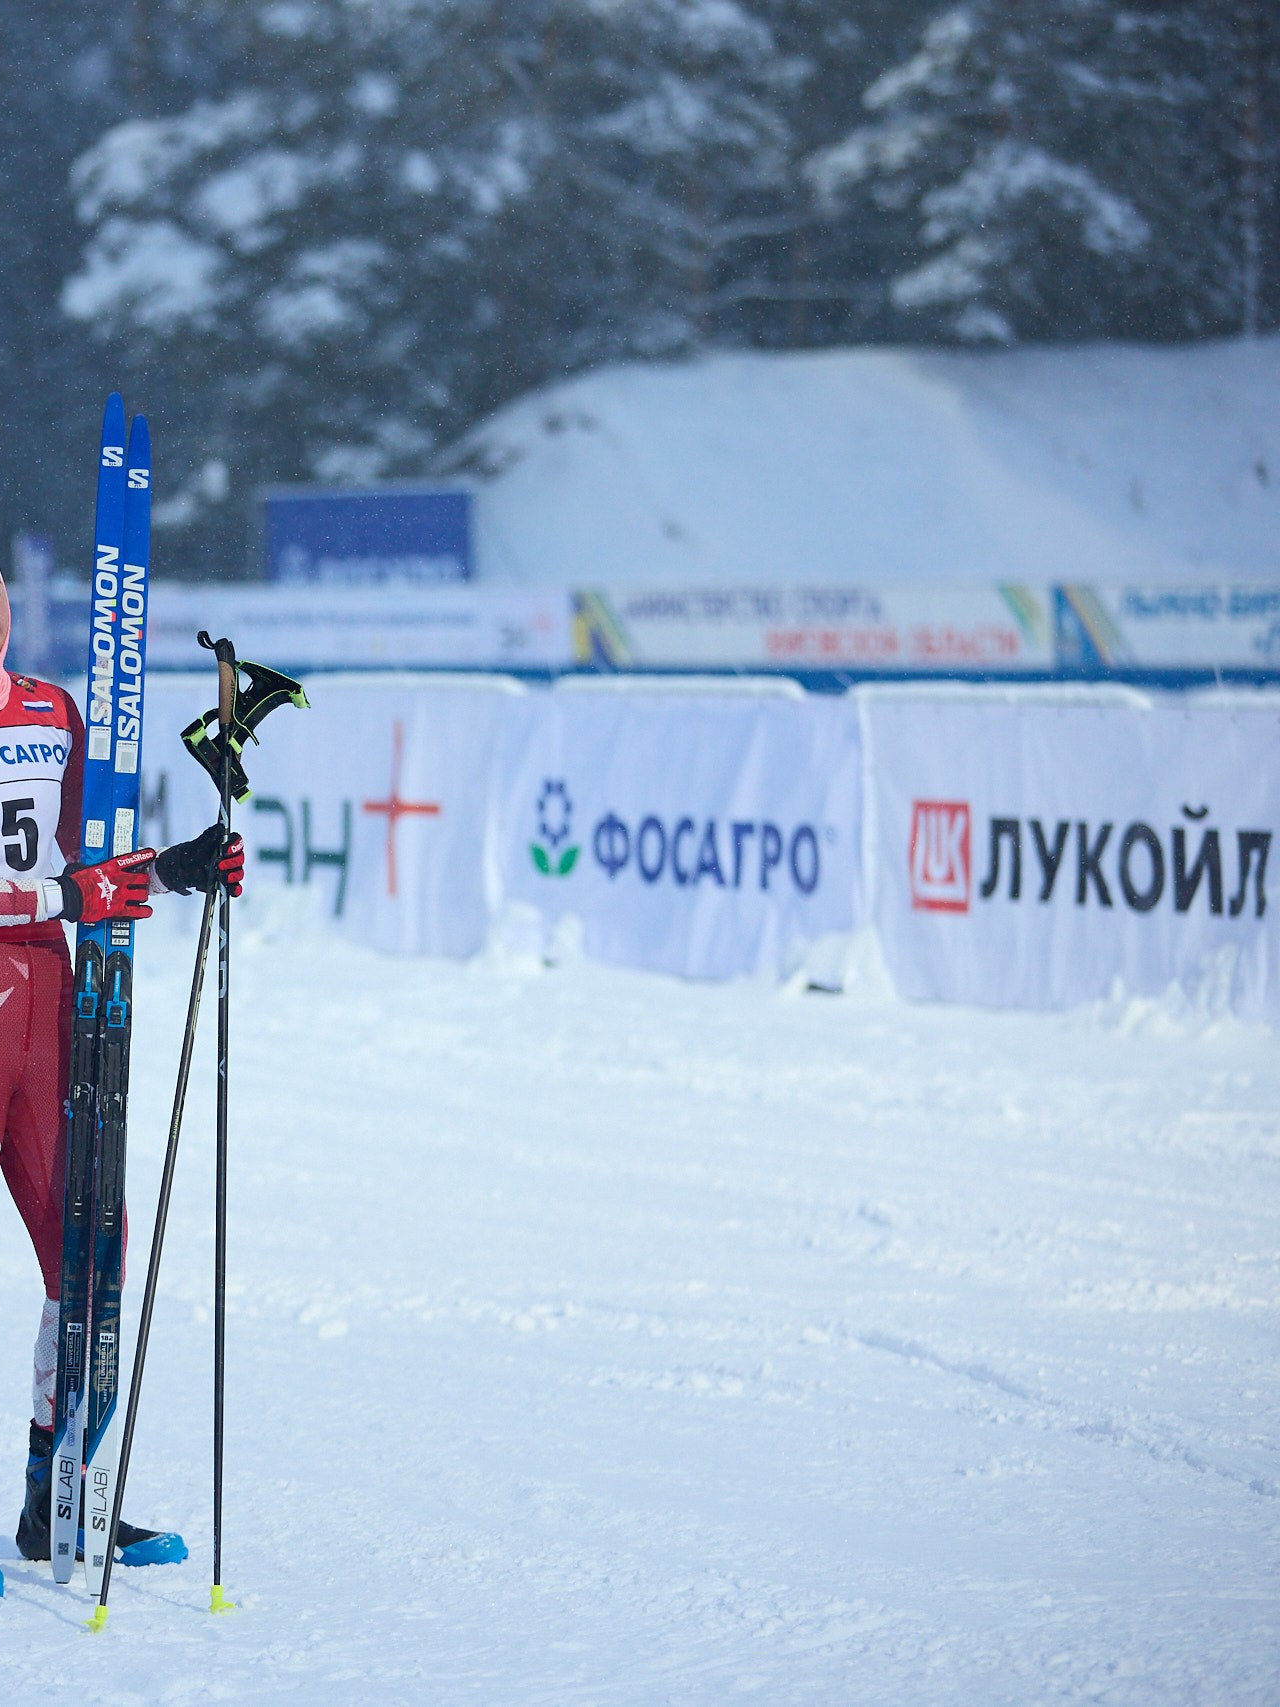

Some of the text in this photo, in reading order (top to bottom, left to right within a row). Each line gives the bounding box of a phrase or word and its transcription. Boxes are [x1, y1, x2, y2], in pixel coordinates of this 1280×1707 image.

[90, 544, 119, 726] SALOMON
[117, 564, 146, 741] SALOMON
[1, 798, 38, 871] 5
[593, 811, 820, 892] ФОСАГРО
[979, 803, 1273, 918] ЛУКОЙЛ
